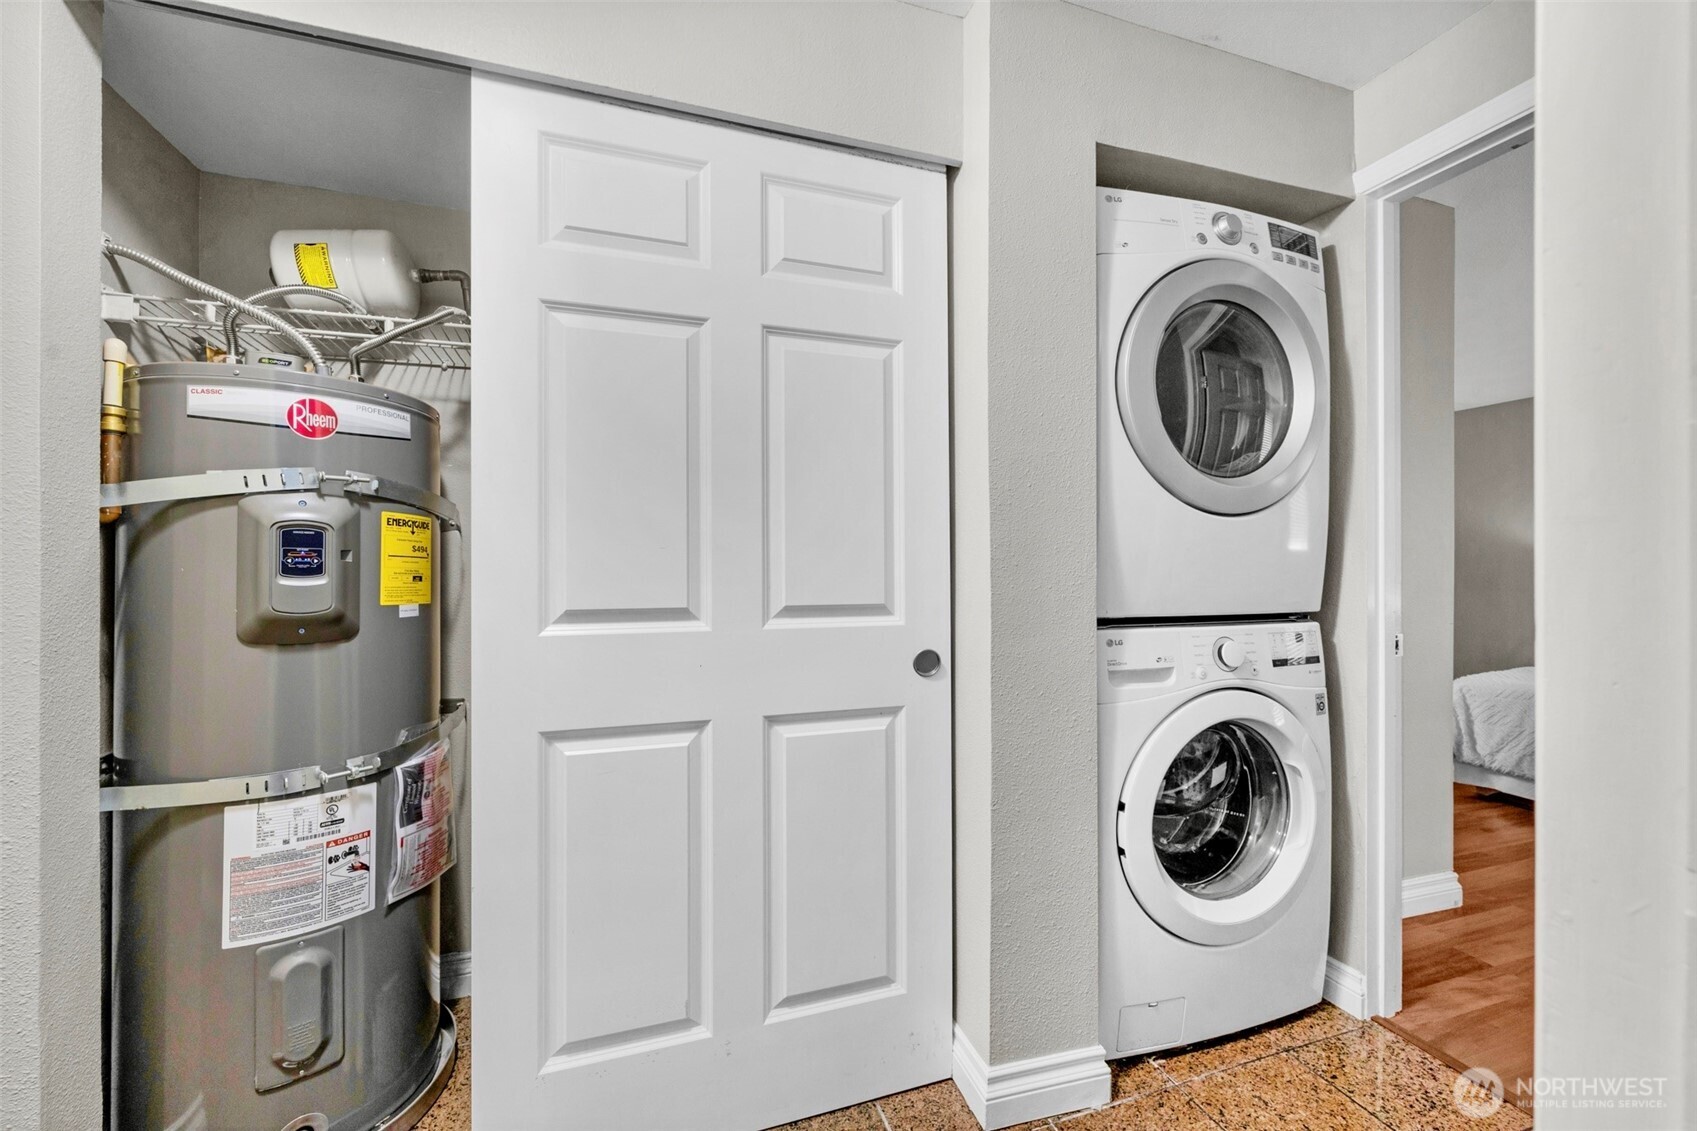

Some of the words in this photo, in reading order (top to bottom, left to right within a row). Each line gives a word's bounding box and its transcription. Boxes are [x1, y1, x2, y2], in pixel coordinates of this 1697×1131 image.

[321, 250, 334, 284] WARNING
[293, 398, 336, 432] Rheem
[356, 404, 410, 423] PROFESSIONAL
[337, 831, 369, 845] DANGER
